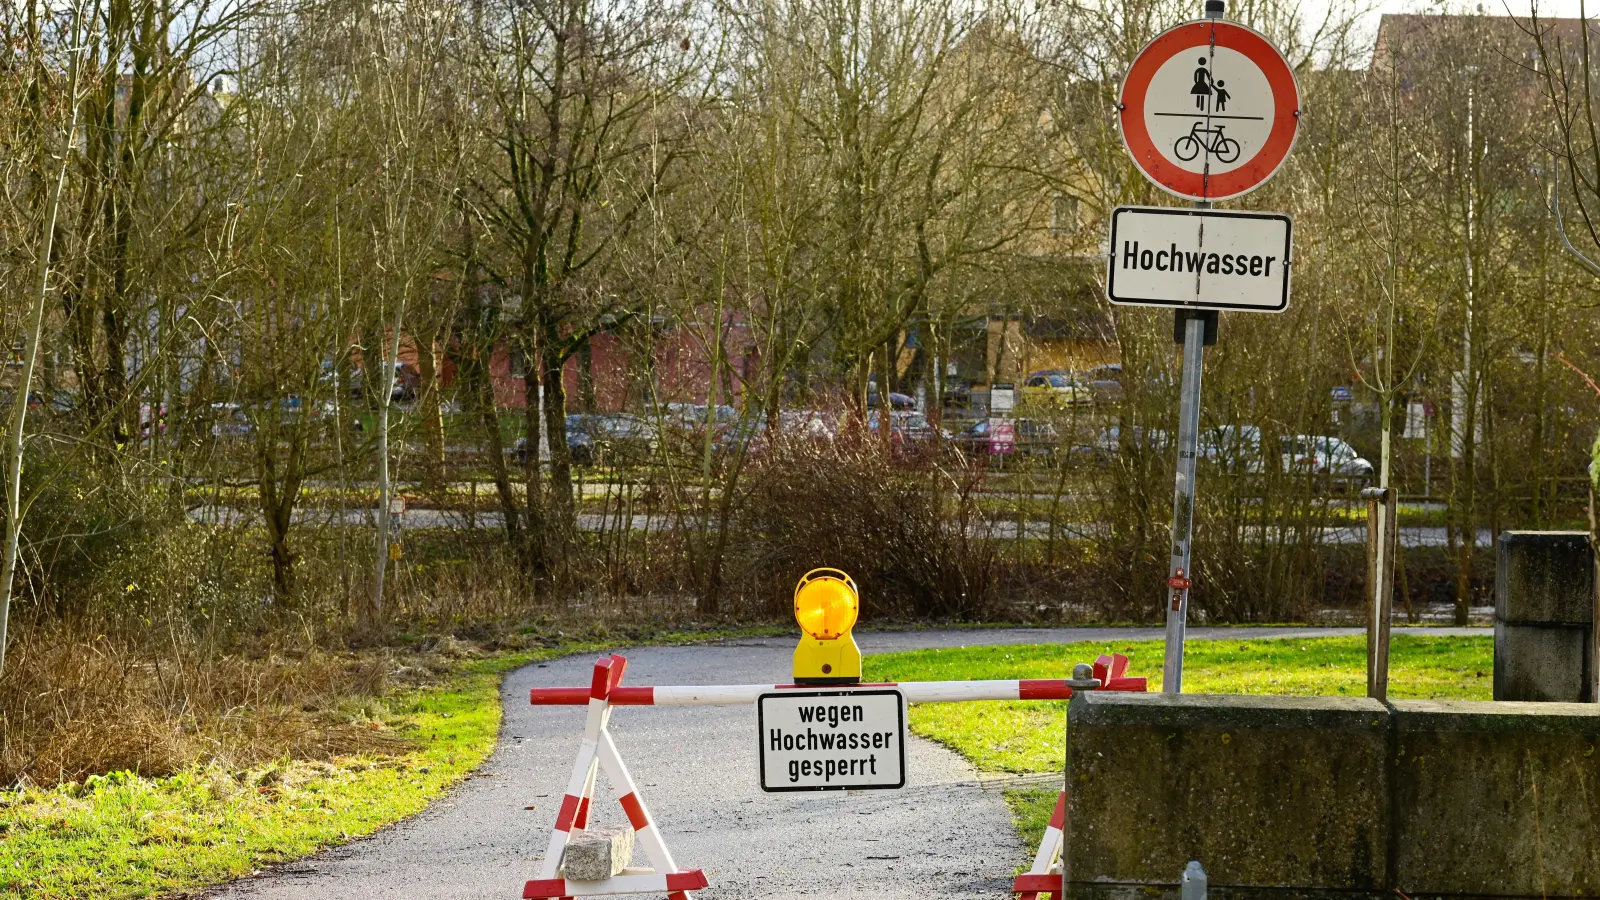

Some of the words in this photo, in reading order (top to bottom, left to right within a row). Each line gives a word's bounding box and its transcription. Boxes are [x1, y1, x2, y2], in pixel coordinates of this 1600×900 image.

[1123, 240, 1276, 277] Hochwasser
[798, 705, 863, 728] wegen
[770, 728, 893, 751] Hochwasser
[788, 754, 877, 783] gesperrt
